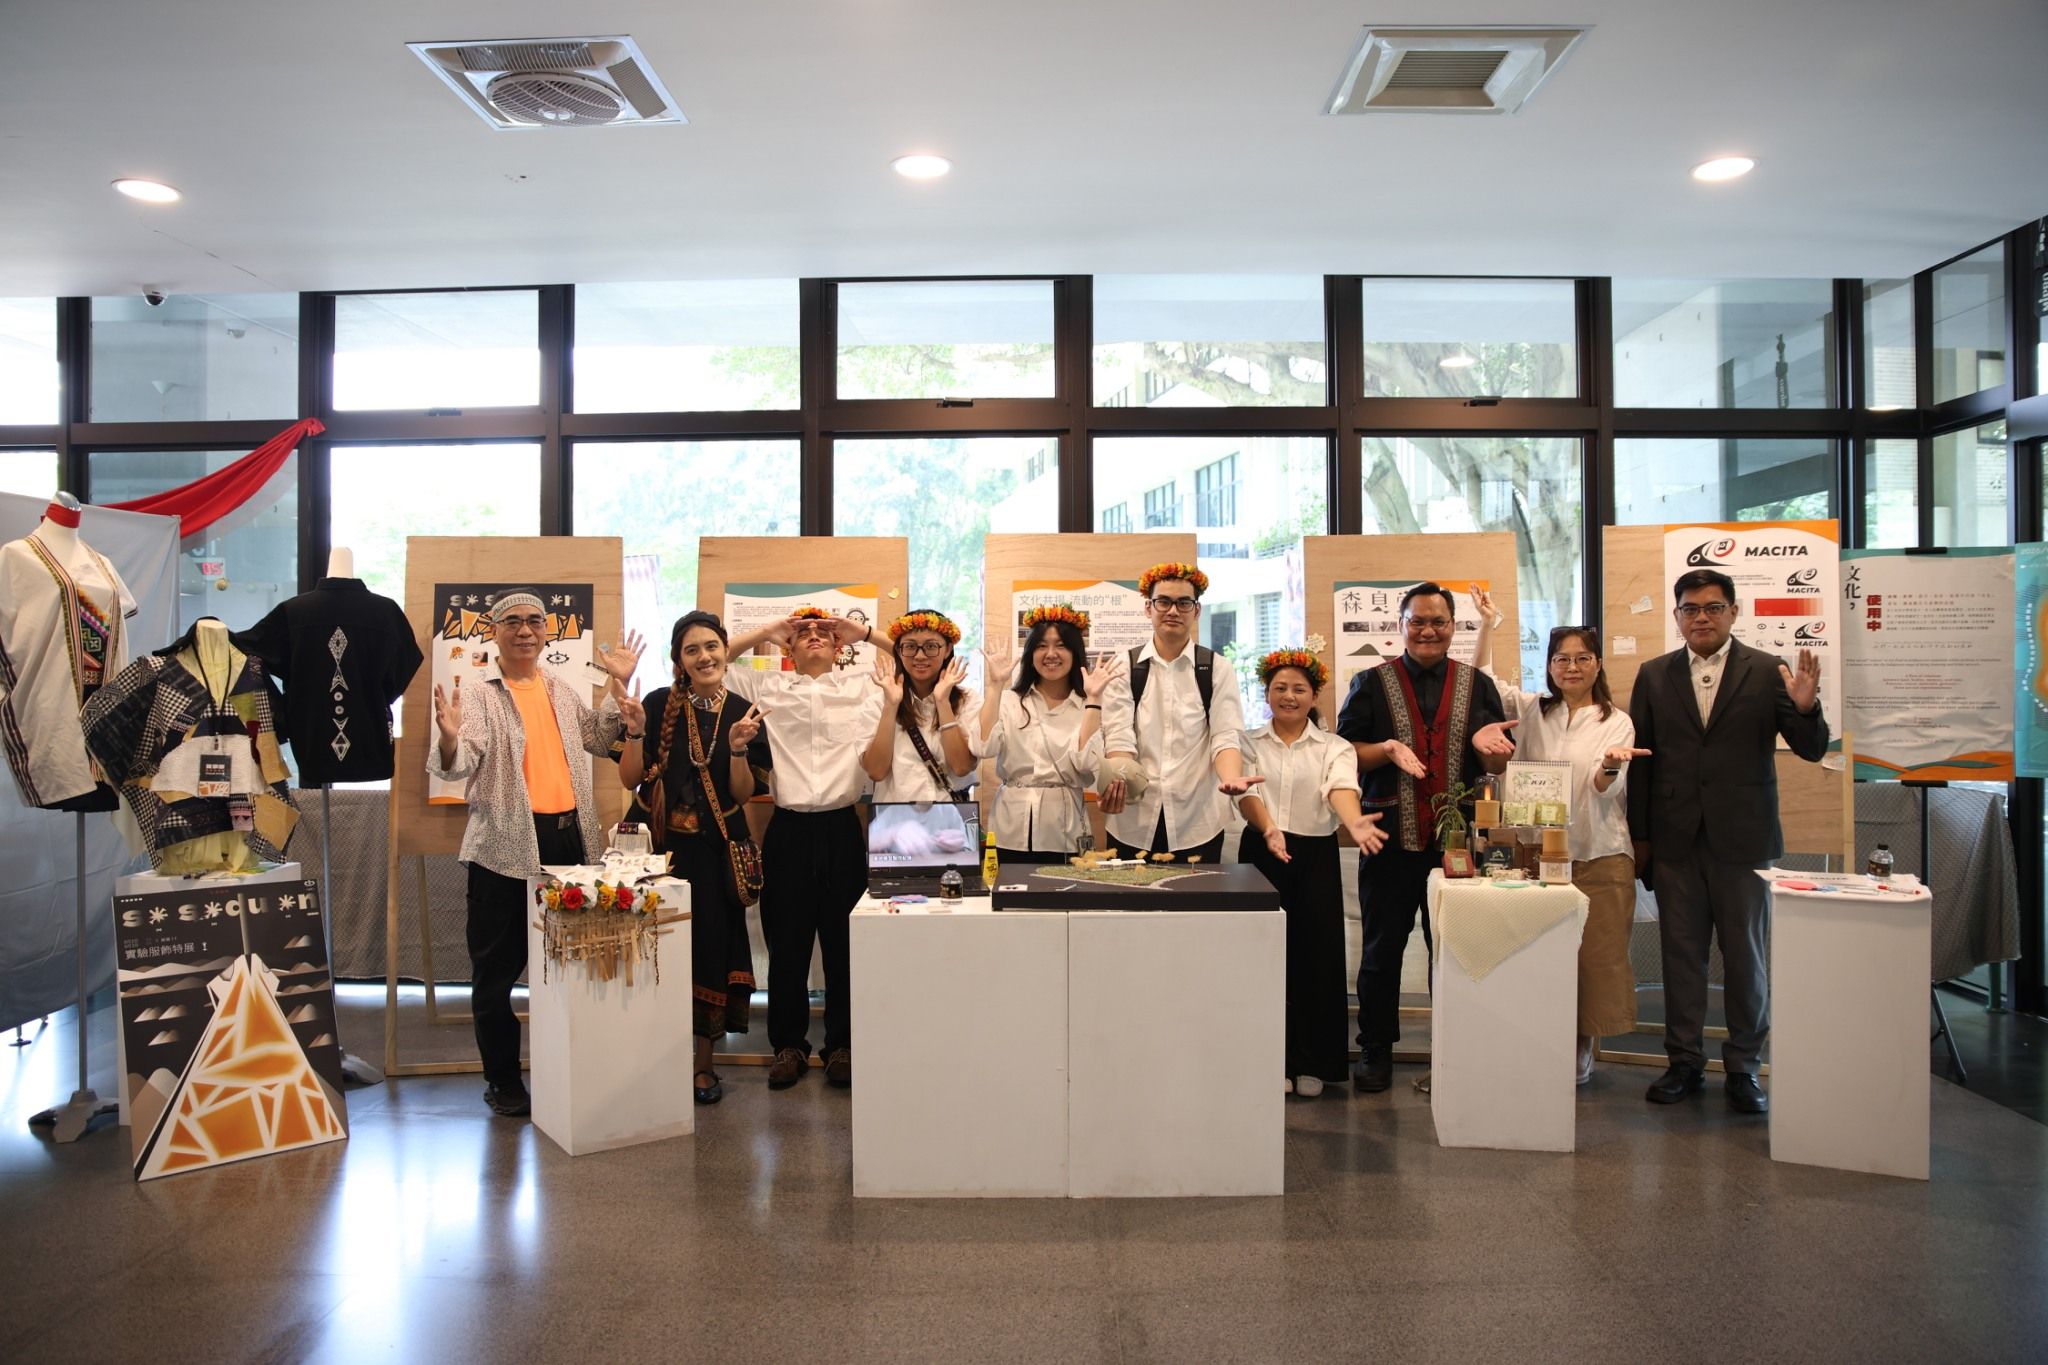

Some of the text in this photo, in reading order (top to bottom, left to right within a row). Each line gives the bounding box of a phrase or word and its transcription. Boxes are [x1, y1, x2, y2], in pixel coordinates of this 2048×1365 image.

[1744, 545, 1808, 557] MACITA
[1866, 595, 1882, 631] 使用中
